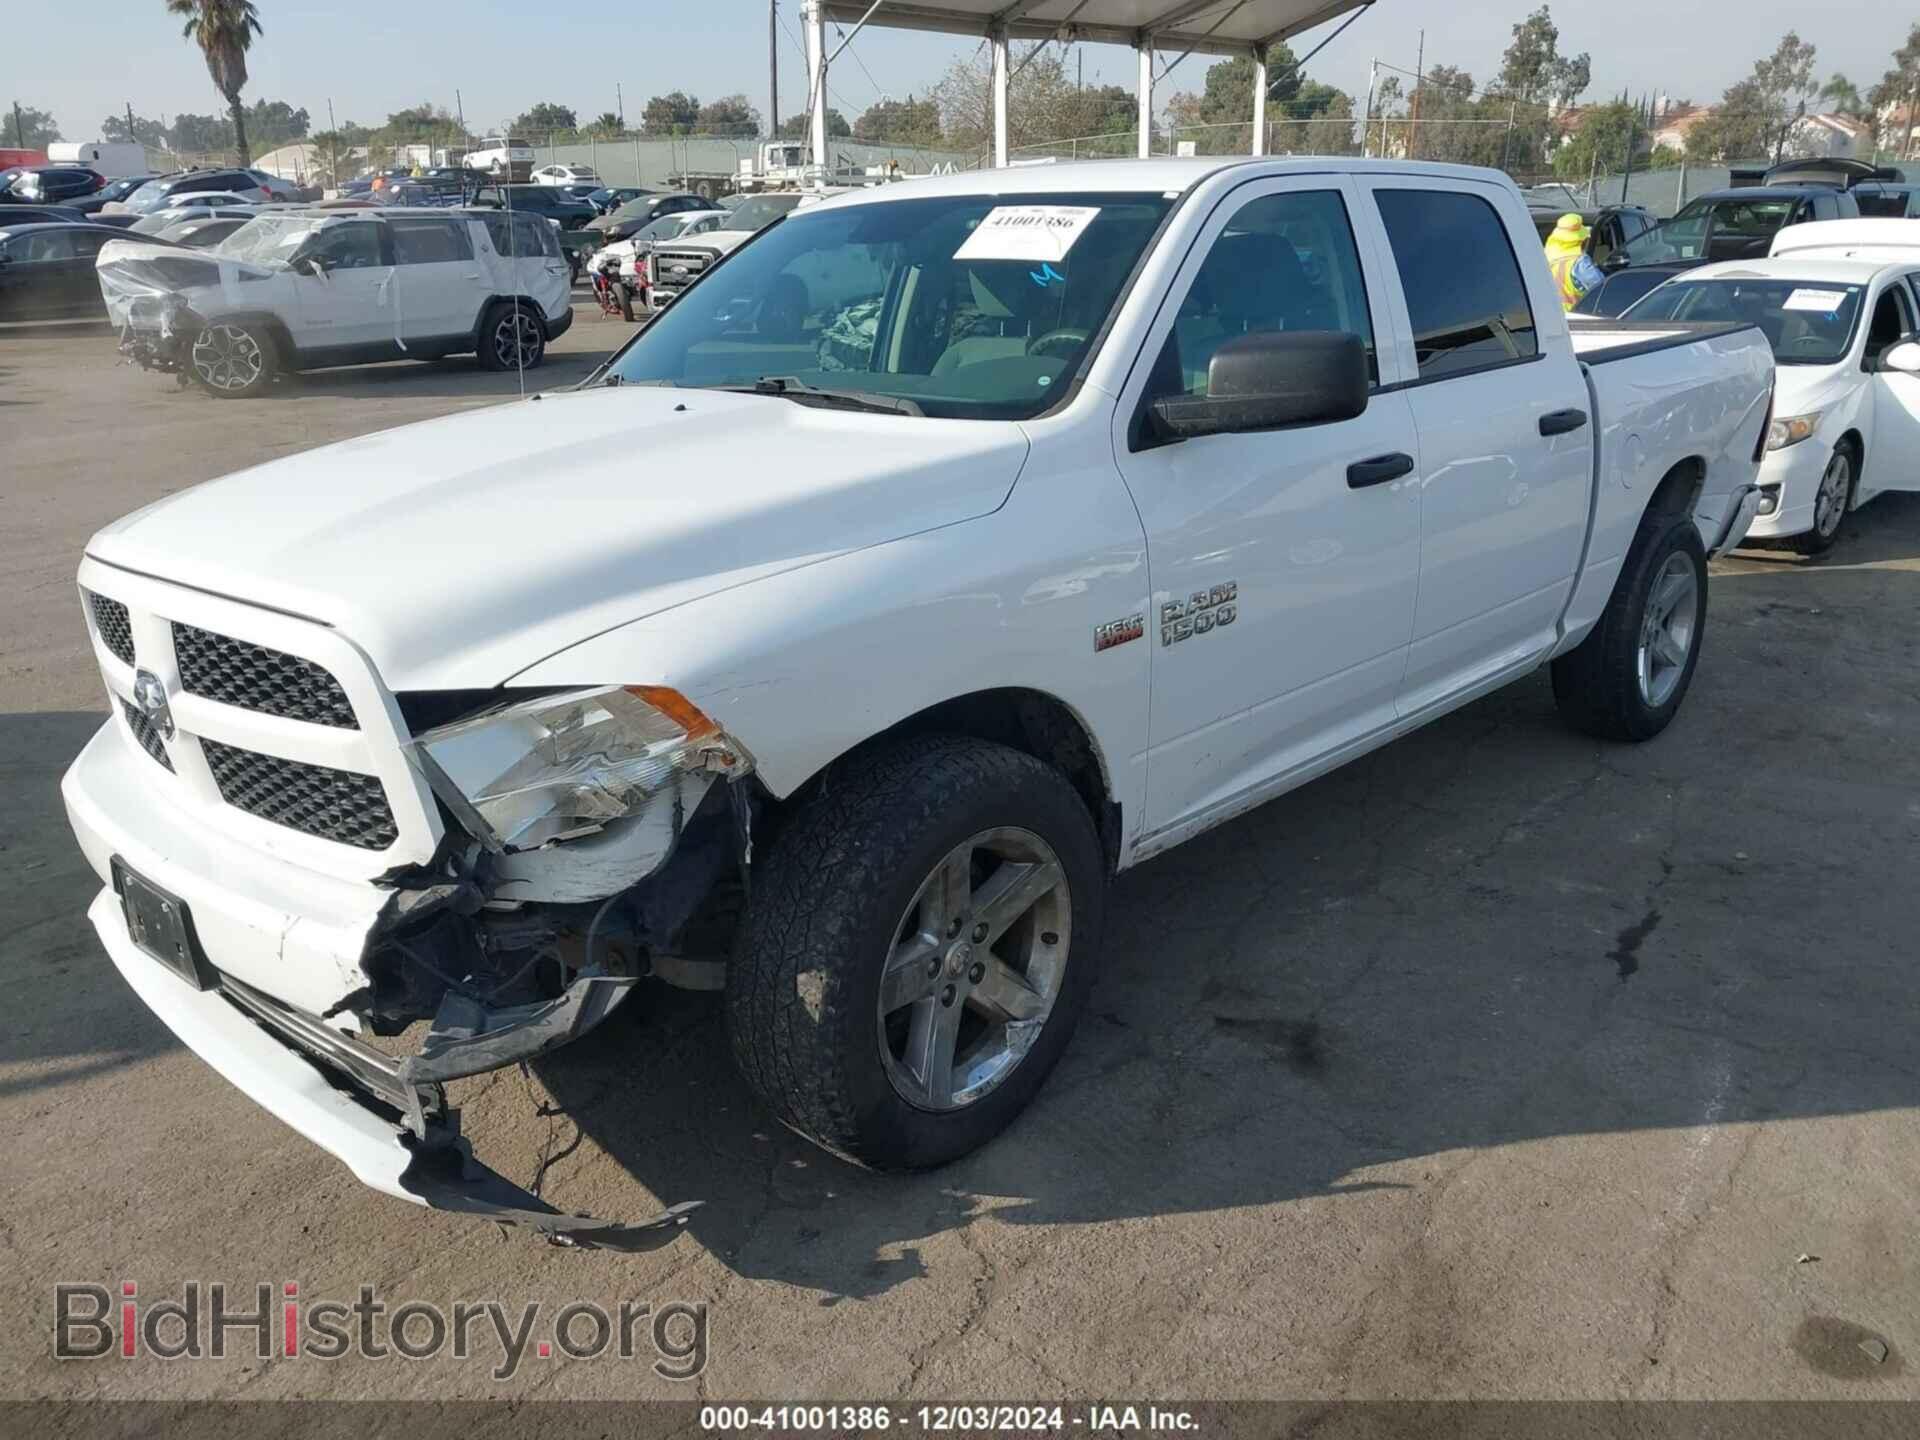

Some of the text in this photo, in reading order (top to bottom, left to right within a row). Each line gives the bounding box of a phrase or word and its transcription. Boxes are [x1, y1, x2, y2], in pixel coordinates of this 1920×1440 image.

[991, 215, 1074, 229] 41001386
[1161, 581, 1237, 624] RAM
[1161, 603, 1237, 645] 1500
